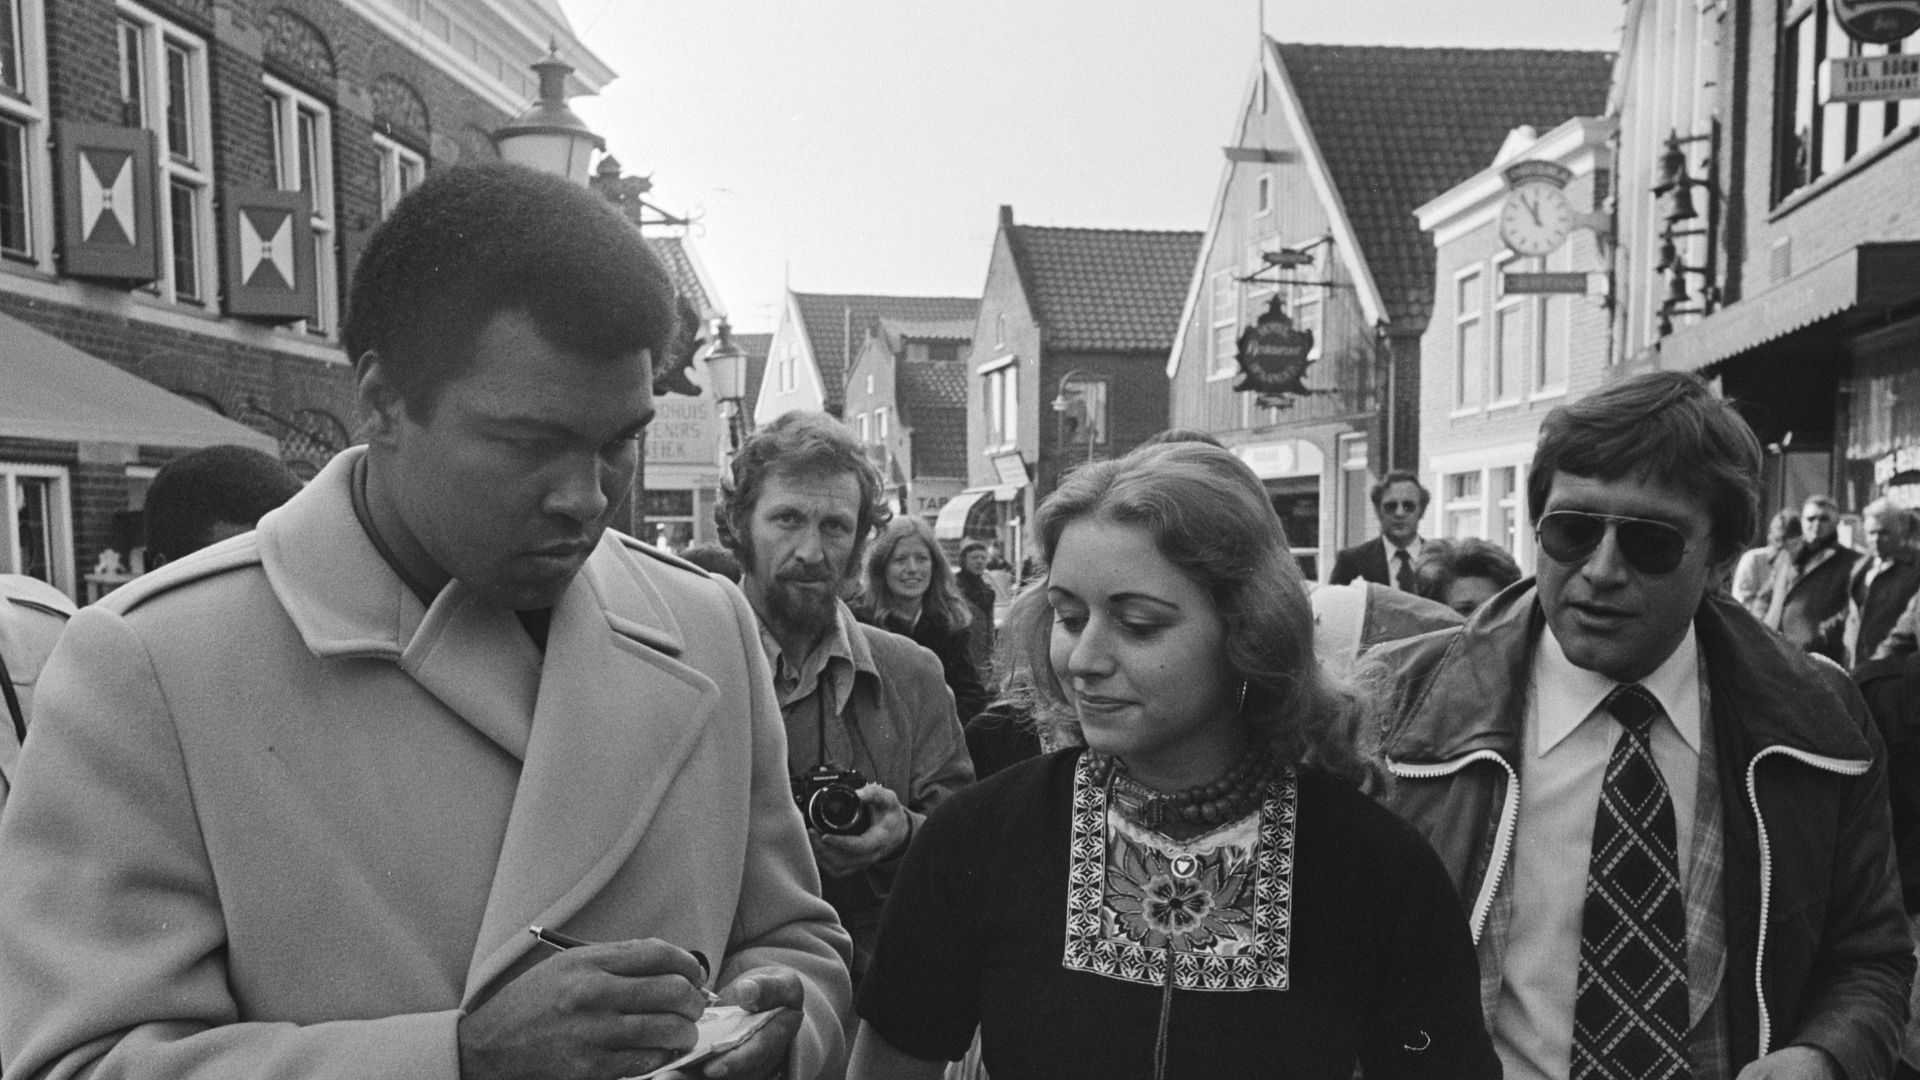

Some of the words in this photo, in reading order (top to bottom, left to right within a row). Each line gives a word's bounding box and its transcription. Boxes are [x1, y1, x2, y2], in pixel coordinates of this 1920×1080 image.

[1844, 61, 1869, 77] TEA
[659, 403, 708, 420] DHUIS
[652, 422, 702, 439] ENIRS
